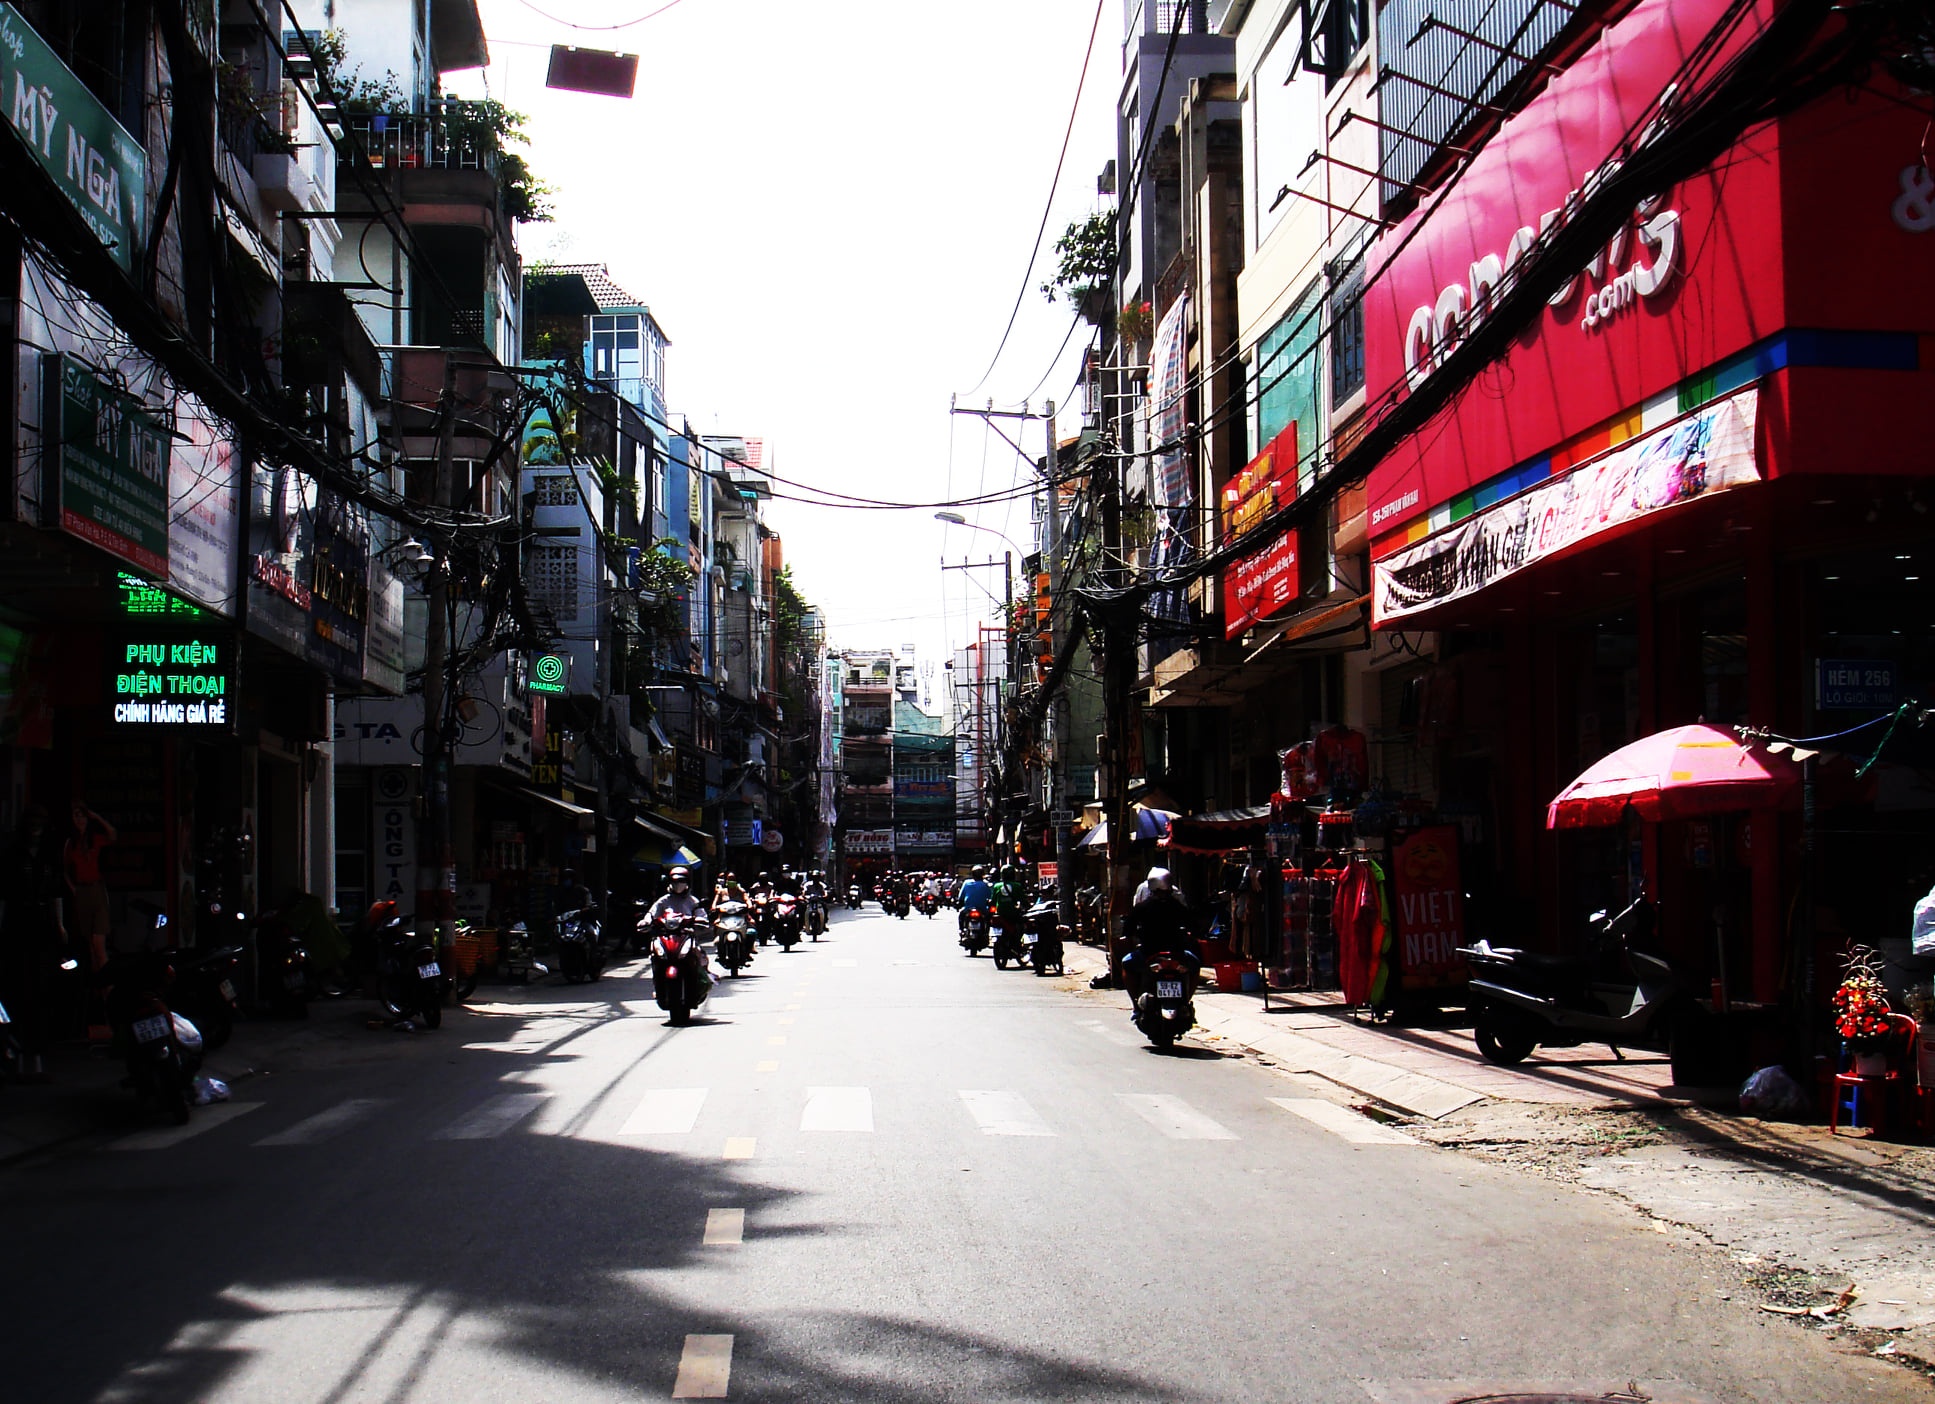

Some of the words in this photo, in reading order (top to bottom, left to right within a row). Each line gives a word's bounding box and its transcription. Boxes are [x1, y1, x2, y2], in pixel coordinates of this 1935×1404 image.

[13, 70, 58, 158] MỸ
[66, 123, 121, 227] NGA
[129, 419, 164, 489] NGA
[126, 644, 166, 667] PHỤ
[171, 640, 217, 667] KIỆN
[117, 670, 162, 697] ĐIỆN
[167, 675, 225, 697] THOẠI
[529, 681, 566, 693] PHARMACY
[1828, 664, 1860, 686] HẺM
[1865, 670, 1891, 686] 256
[114, 699, 150, 723] CHÍNH
[152, 700, 185, 724] HÃNG
[187, 699, 207, 724] GIÁ
[209, 698, 225, 724] RẺ
[353, 723, 402, 745] TẠ
[385, 808, 403, 857] ÔNG
[385, 863, 403, 898] TẠ
[1400, 887, 1455, 928] VIỆT
[1405, 929, 1459, 966] NAM
